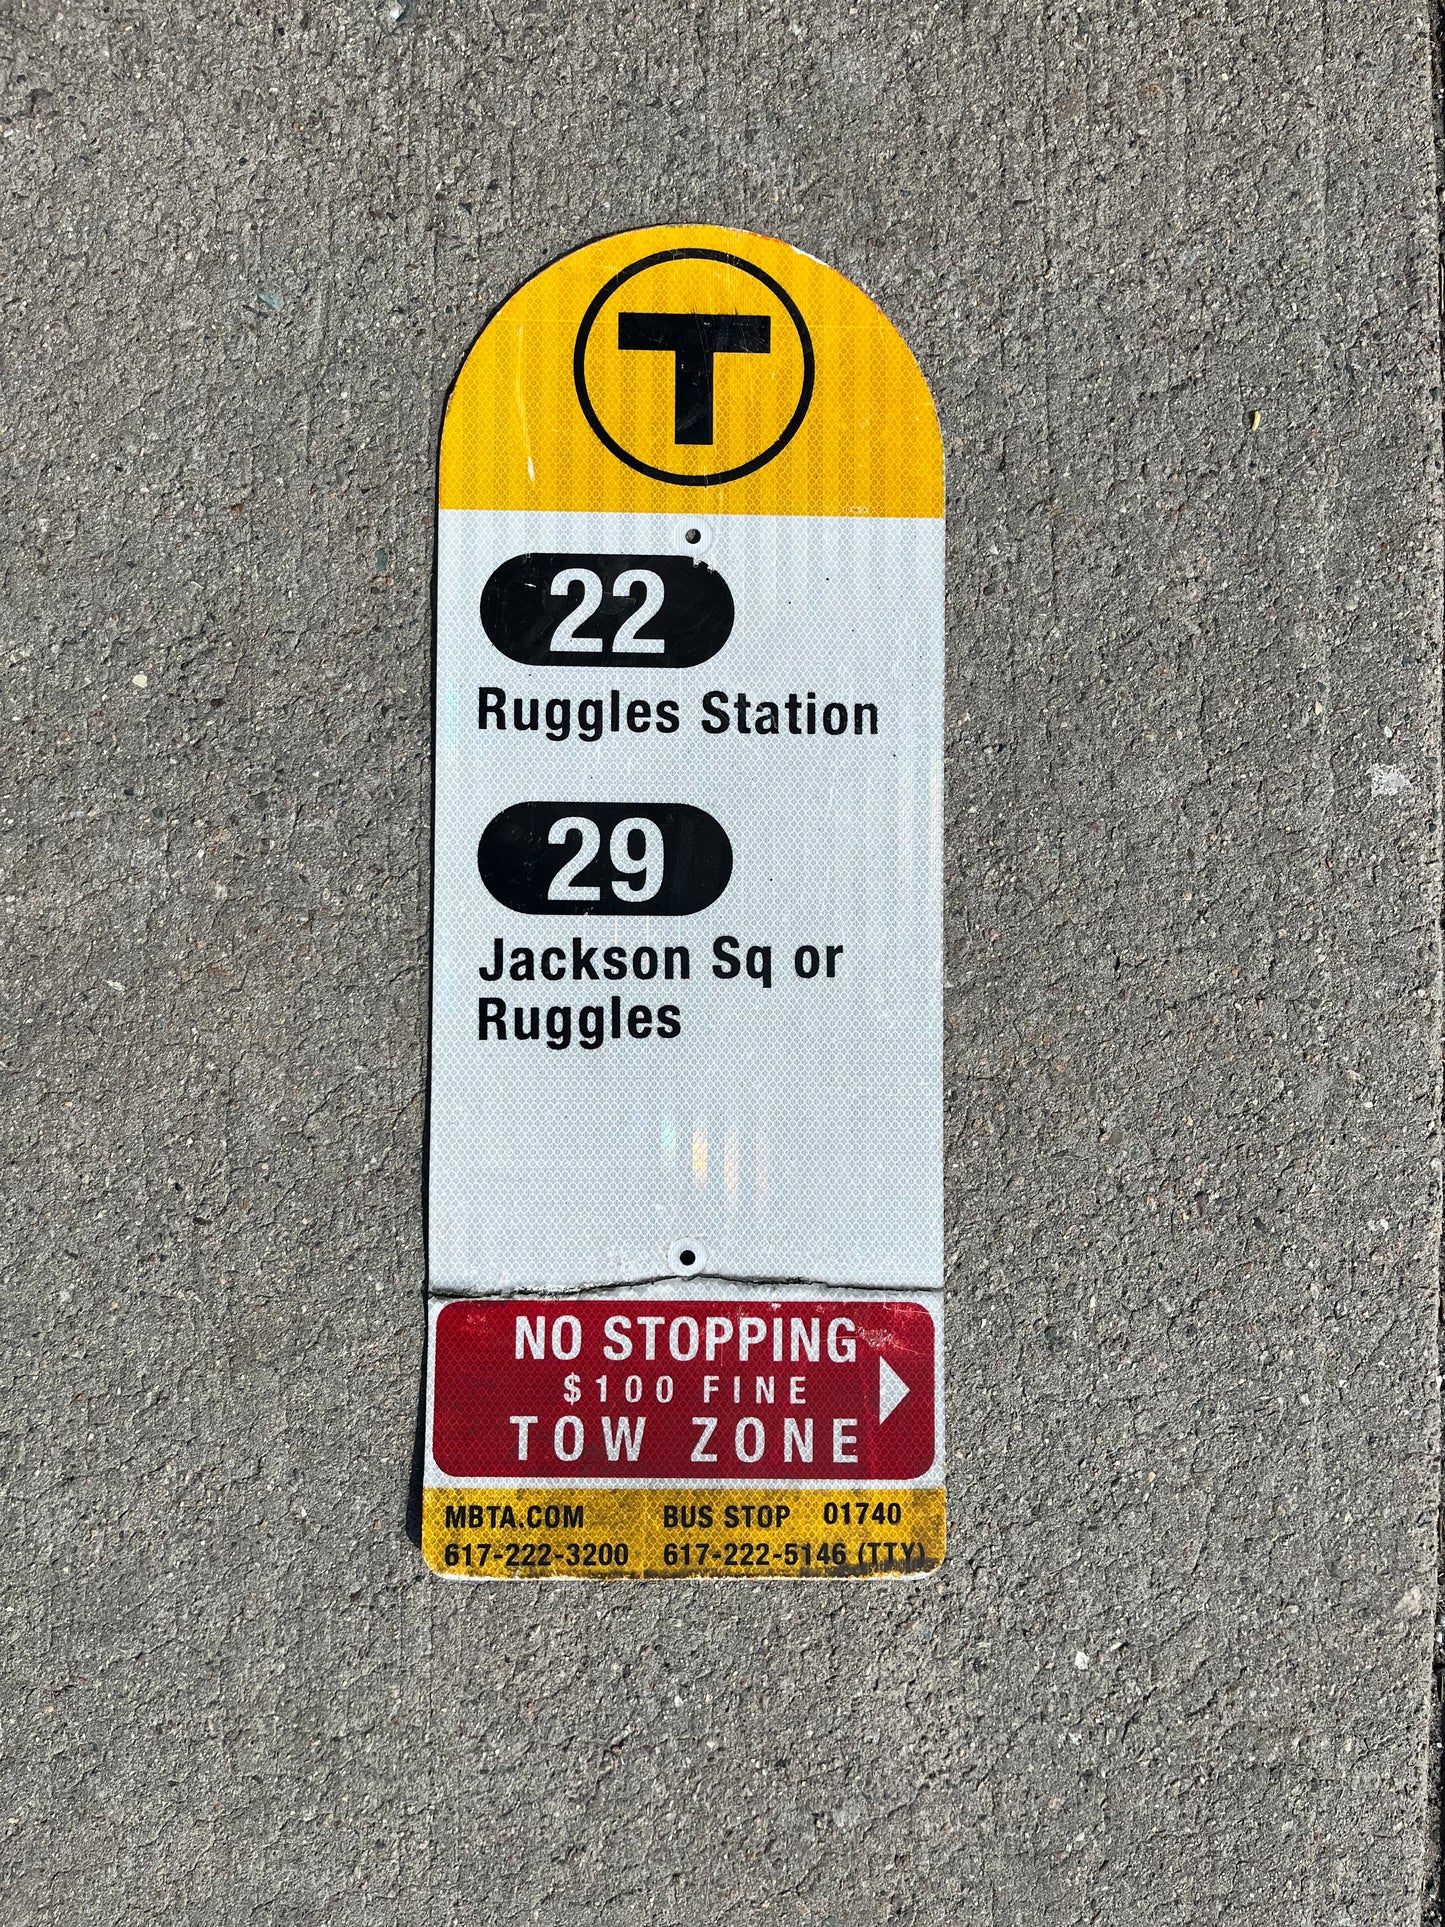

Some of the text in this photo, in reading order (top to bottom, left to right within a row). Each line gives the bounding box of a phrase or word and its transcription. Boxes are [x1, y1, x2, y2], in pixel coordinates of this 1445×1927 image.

[618, 312, 771, 445] T
[549, 568, 665, 654] 22
[478, 687, 878, 741] Ruggles Station
[547, 816, 664, 902] 29
[479, 936, 843, 988] Jackson Sq or
[478, 996, 681, 1049] Ruggles
[514, 1315, 856, 1363] NO STOPPING
[564, 1372, 806, 1406] $100 FINE
[510, 1415, 858, 1464] TOW ZONE
[445, 1505, 584, 1529] MBTA.COM
[664, 1502, 901, 1529] BUS STOP 01740
[444, 1543, 629, 1567] 617-222-3200
[663, 1543, 926, 1568] 617-222-5146 (TTY)
